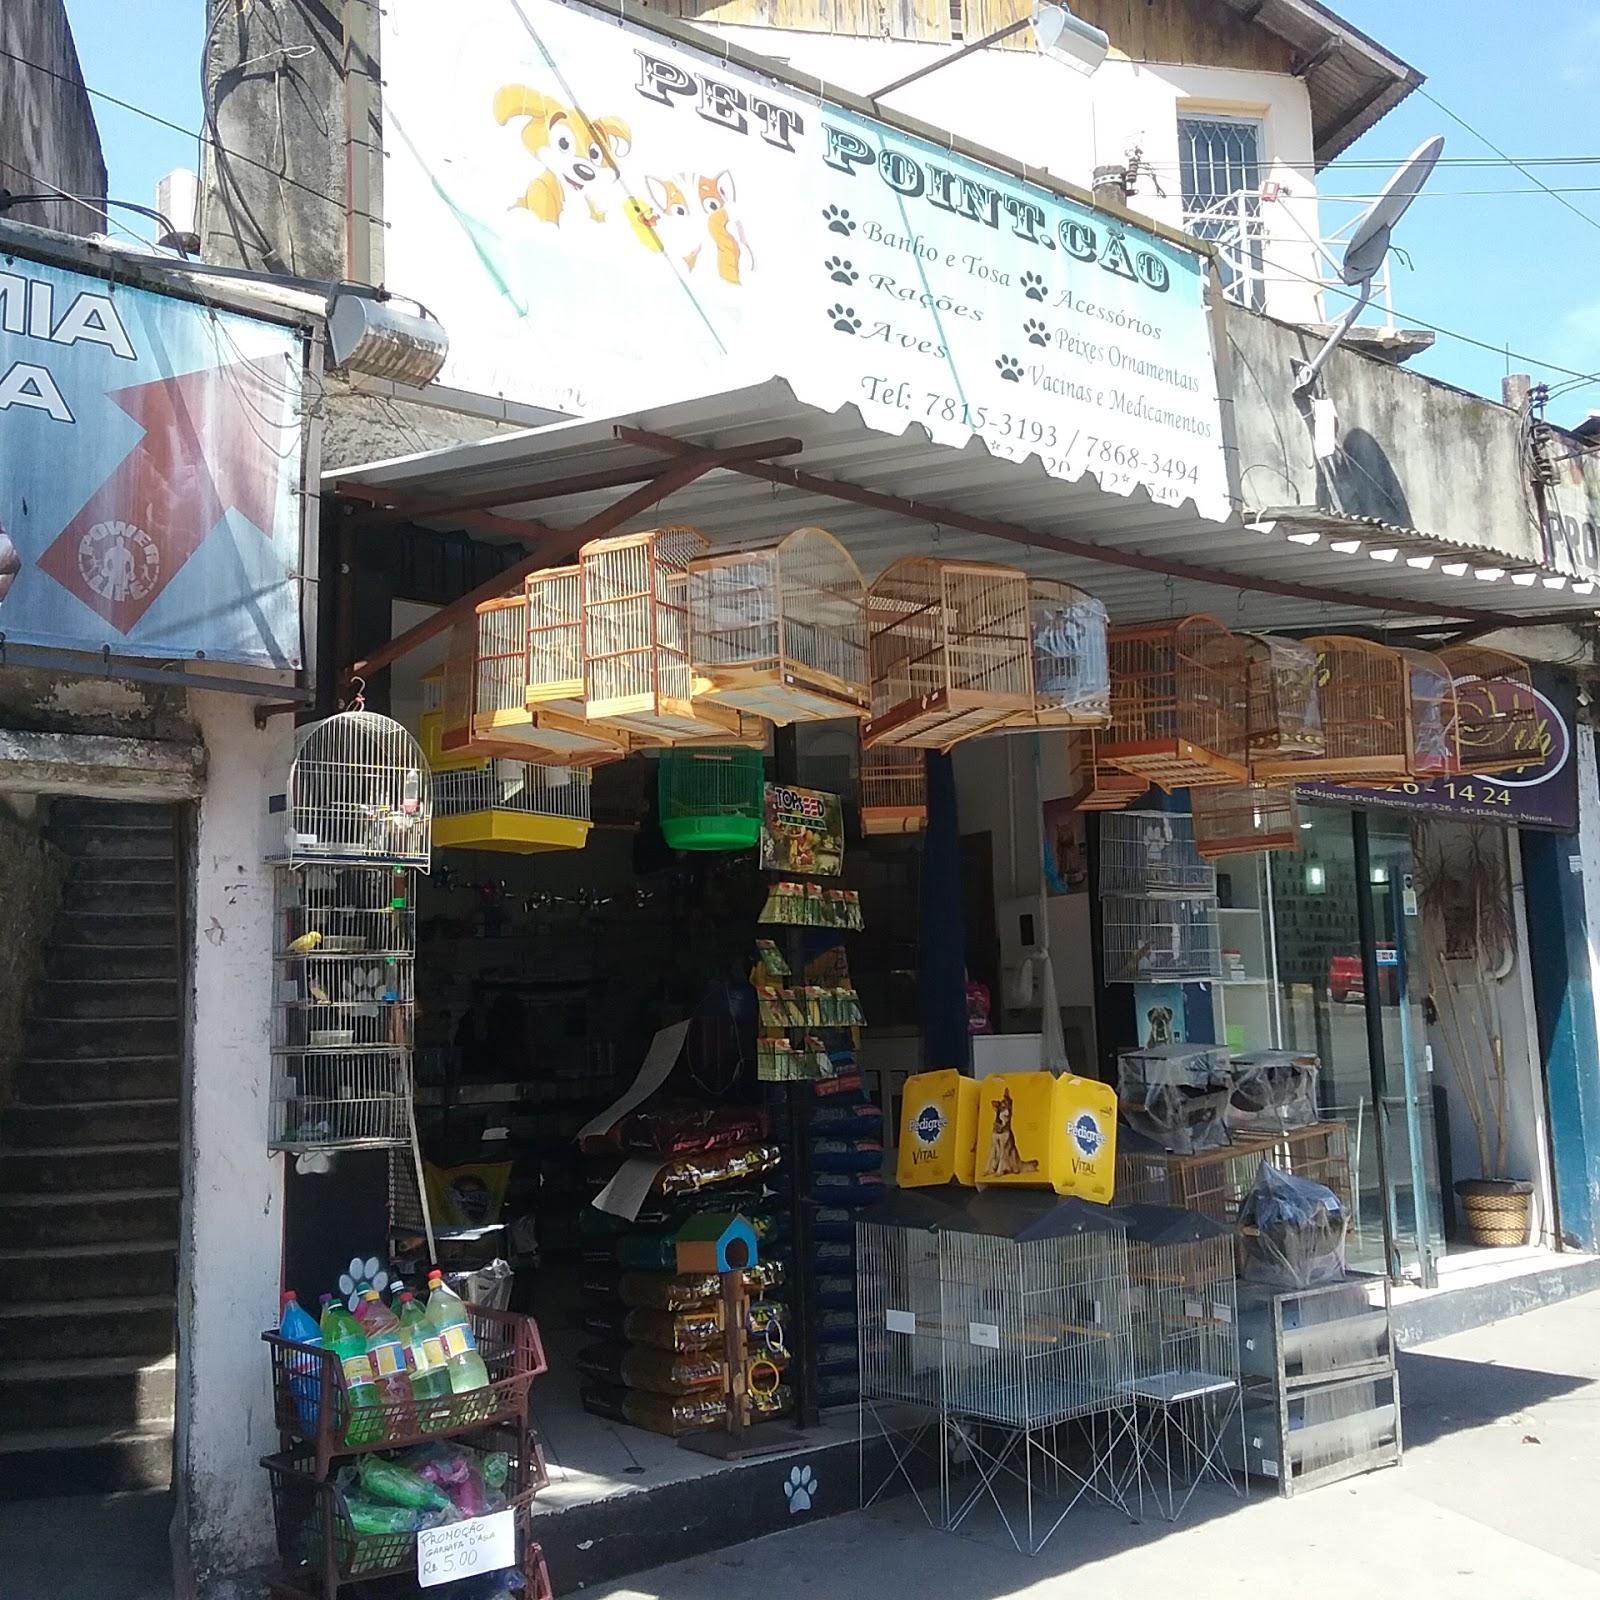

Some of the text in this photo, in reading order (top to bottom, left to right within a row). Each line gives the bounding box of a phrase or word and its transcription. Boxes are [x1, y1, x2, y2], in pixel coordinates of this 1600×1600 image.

[633, 48, 804, 153] PET
[863, 220, 1011, 288] Banho e Tosa
[868, 273, 985, 323] Rações
[1053, 290, 1162, 341] Acessórios
[860, 321, 948, 360] Aves
[1055, 327, 1200, 393] Peixes Ornamentais
[1027, 363, 1212, 438] Vacinas e Medicamentos
[861, 375, 911, 410] Tel:
[926, 393, 1058, 447] 7815-3193
[1065, 429, 1080, 457] /
[1086, 437, 1200, 485] 7868-3494
[1296, 785, 1353, 801] Rodrigues
[420, 1520, 485, 1547] PROMOÇÃO
